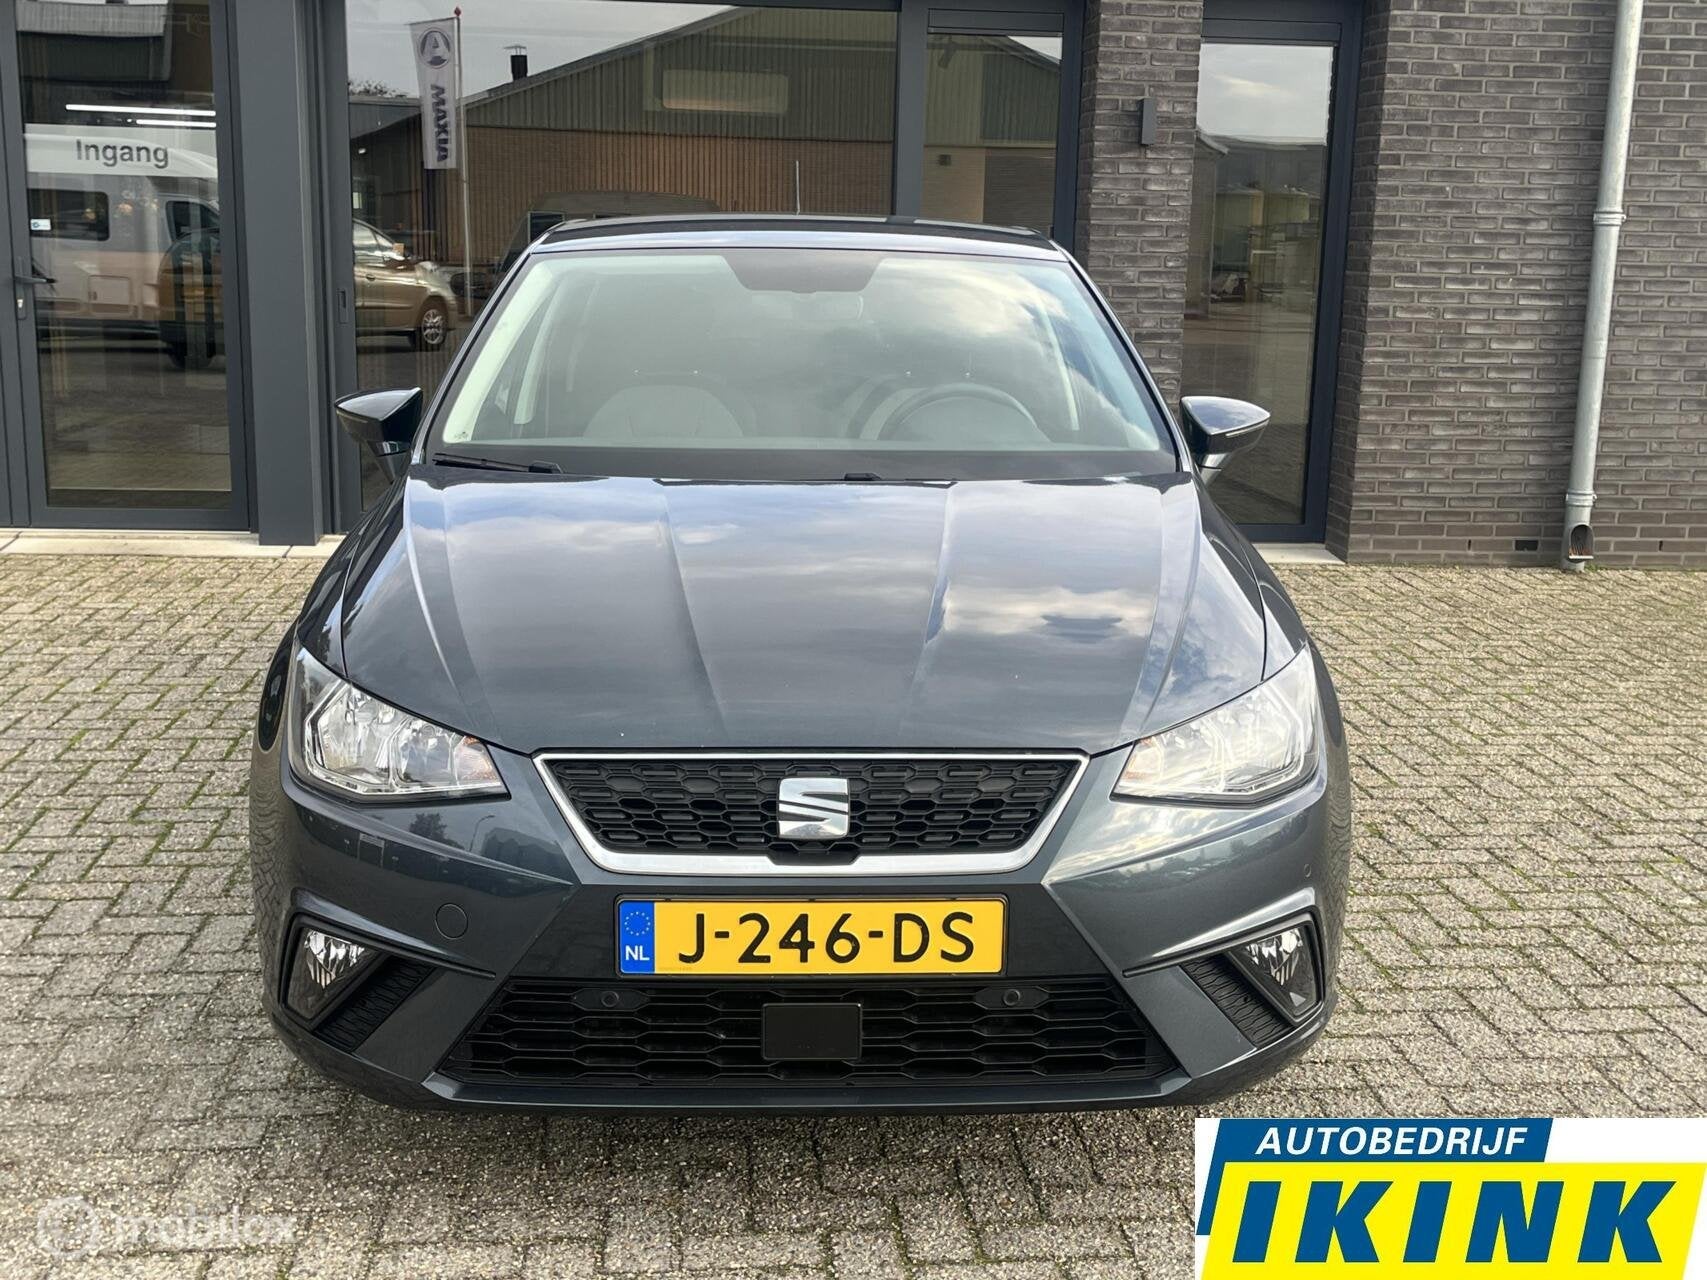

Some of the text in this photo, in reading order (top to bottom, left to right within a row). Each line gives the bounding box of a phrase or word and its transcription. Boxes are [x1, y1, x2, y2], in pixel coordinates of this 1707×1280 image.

[76, 139, 169, 169] Ingang
[625, 911, 975, 964] NL J-246-DS
